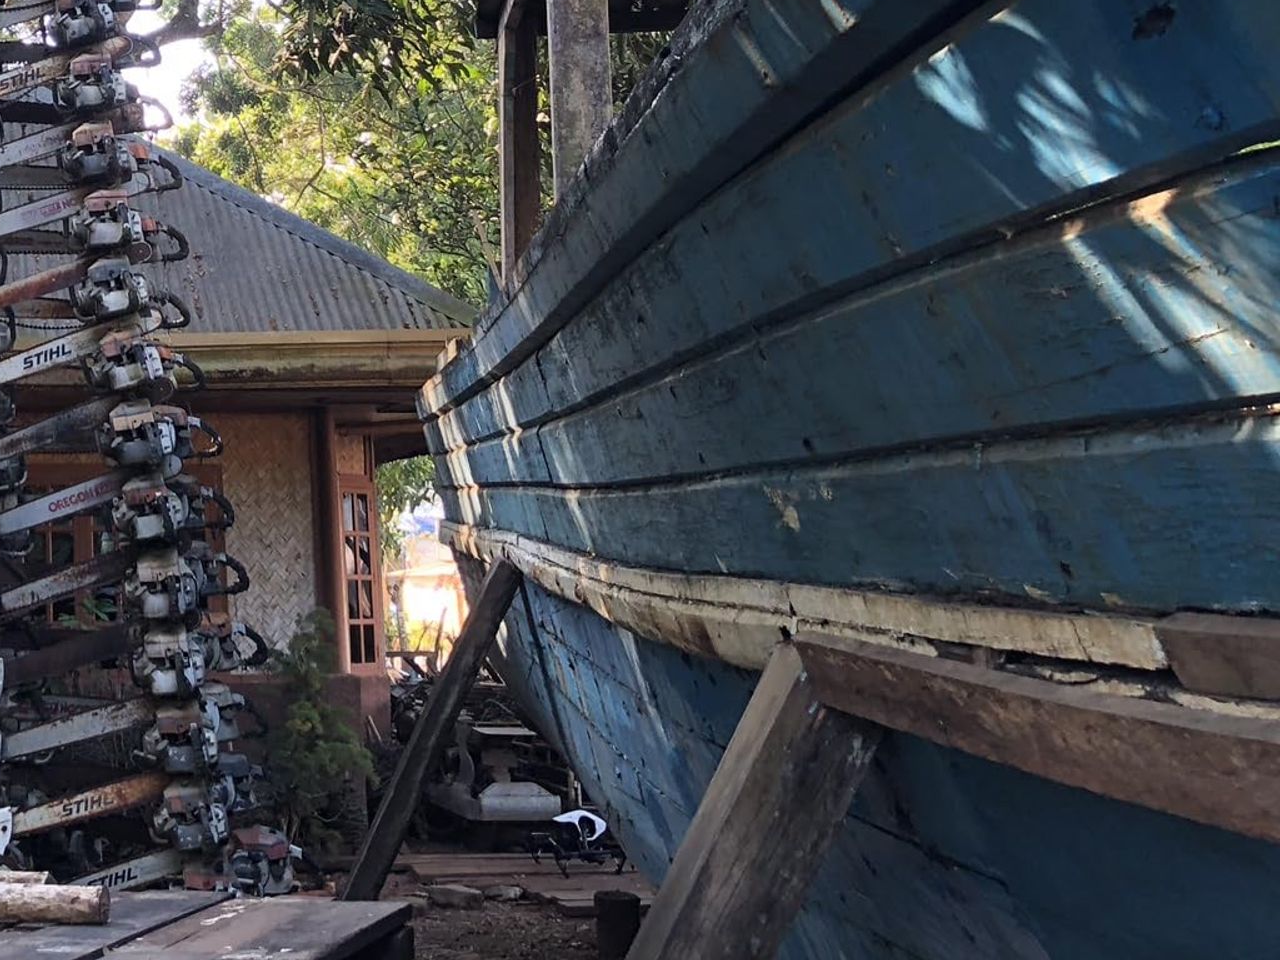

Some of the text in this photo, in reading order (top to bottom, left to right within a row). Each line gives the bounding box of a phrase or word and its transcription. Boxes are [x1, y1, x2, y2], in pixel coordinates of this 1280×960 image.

[0, 68, 45, 91] STIHL
[22, 343, 73, 371] STIHL
[48, 487, 96, 513] OREGON
[61, 796, 115, 817] STIHL
